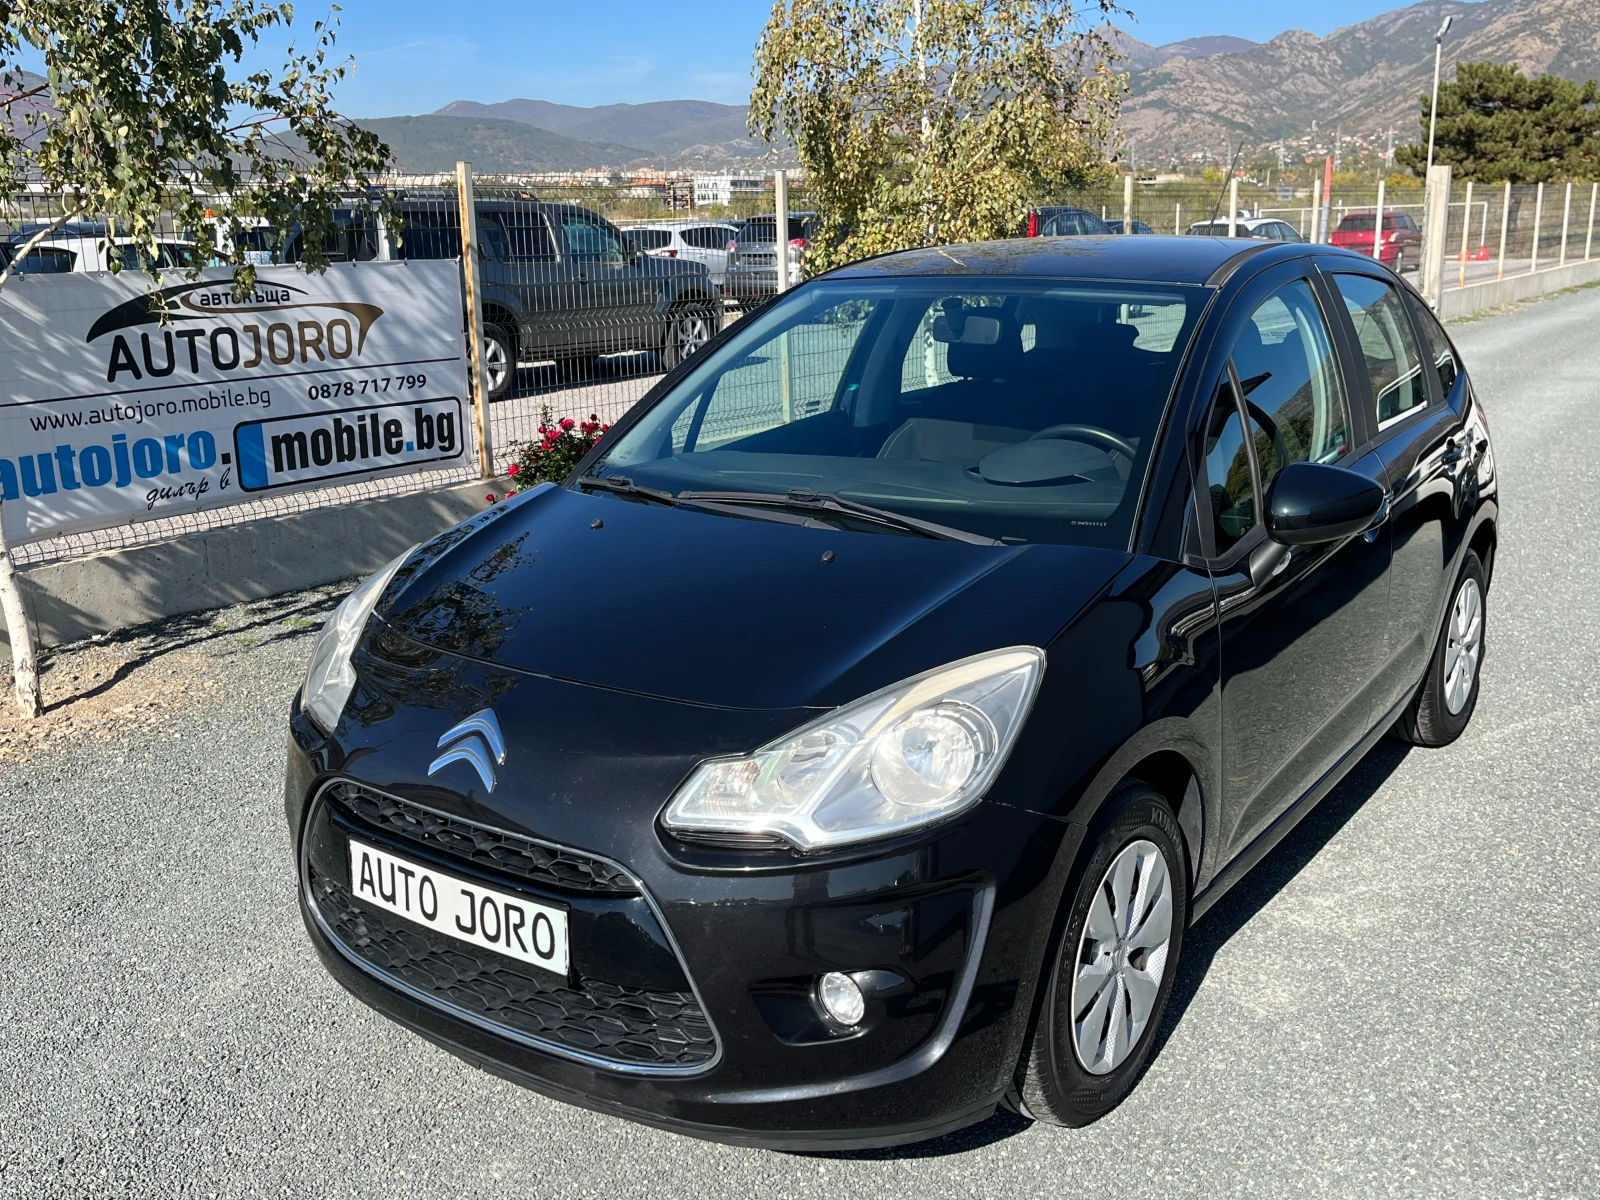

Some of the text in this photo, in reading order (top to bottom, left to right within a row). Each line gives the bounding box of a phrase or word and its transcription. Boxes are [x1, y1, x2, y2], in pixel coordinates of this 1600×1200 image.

[29, 386, 271, 432] www.autojoro.mobile.bg
[308, 374, 427, 400] 0878 717 799
[271, 407, 455, 473] mobile.bg
[359, 851, 556, 960] AUTO JORO
